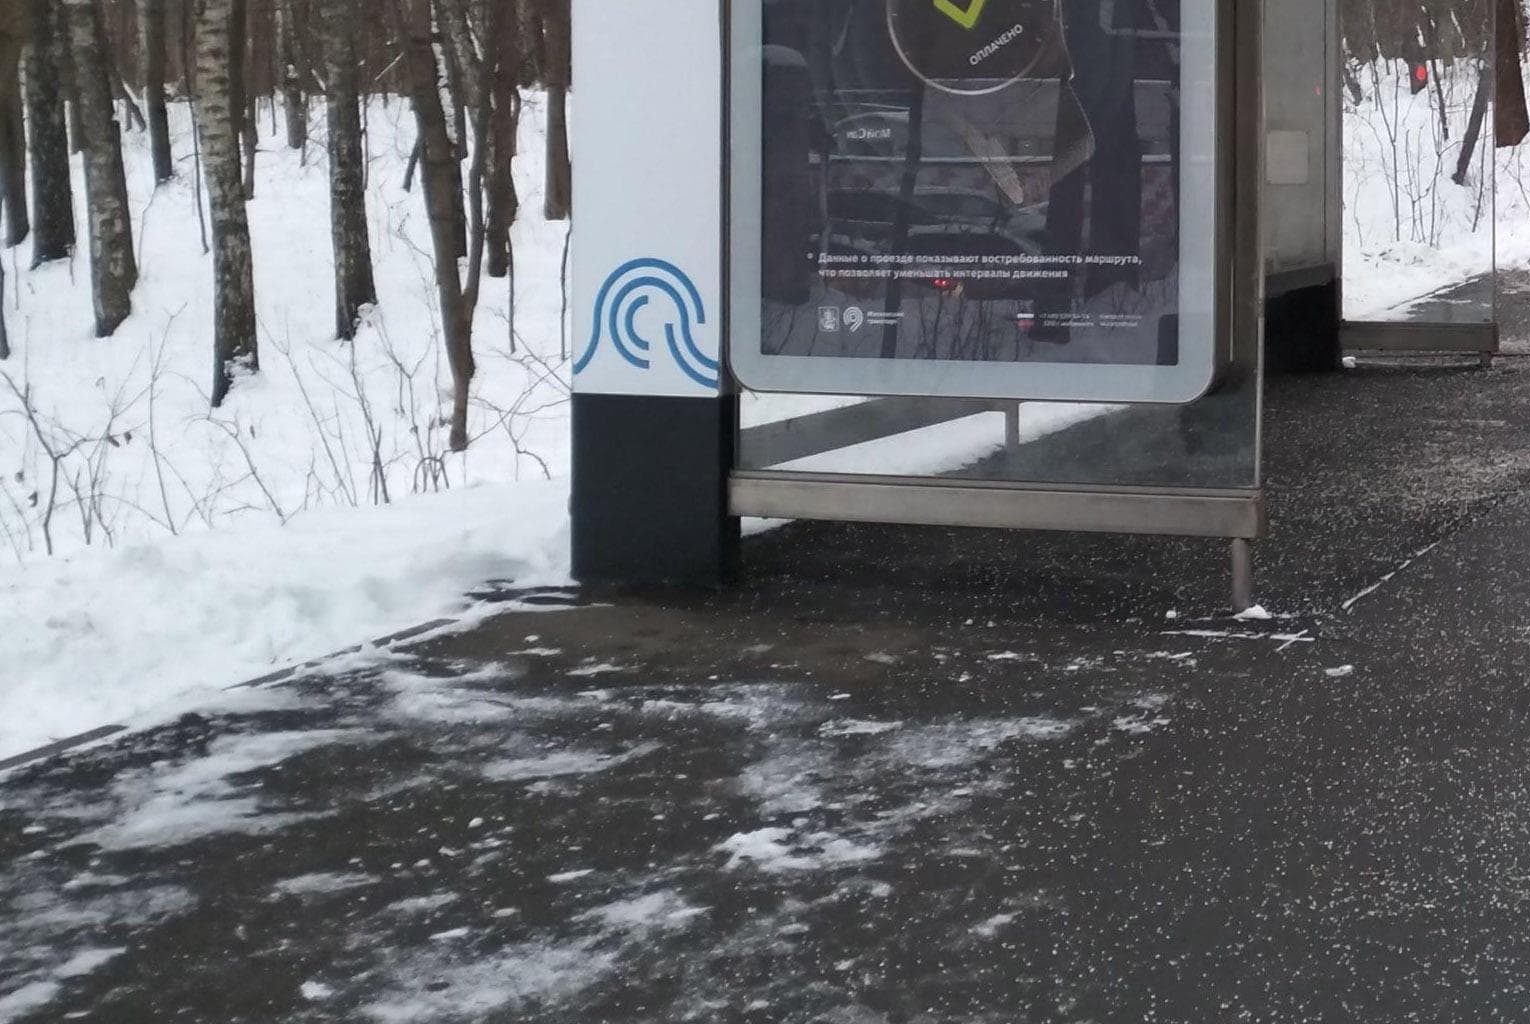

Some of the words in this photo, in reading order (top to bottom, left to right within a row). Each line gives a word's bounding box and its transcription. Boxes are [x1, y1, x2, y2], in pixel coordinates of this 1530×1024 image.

[969, 24, 1023, 65] ОПЛАЧЕНО
[817, 252, 859, 264] Данные
[860, 254, 868, 263] о
[870, 254, 914, 265] проезде
[915, 254, 979, 264] показывают
[981, 253, 1083, 265] востребованность
[818, 269, 836, 278] что
[837, 269, 892, 278] позволяет
[893, 269, 951, 280] уменьшать
[952, 269, 1011, 279] интервалы
[1012, 269, 1069, 280] движения
